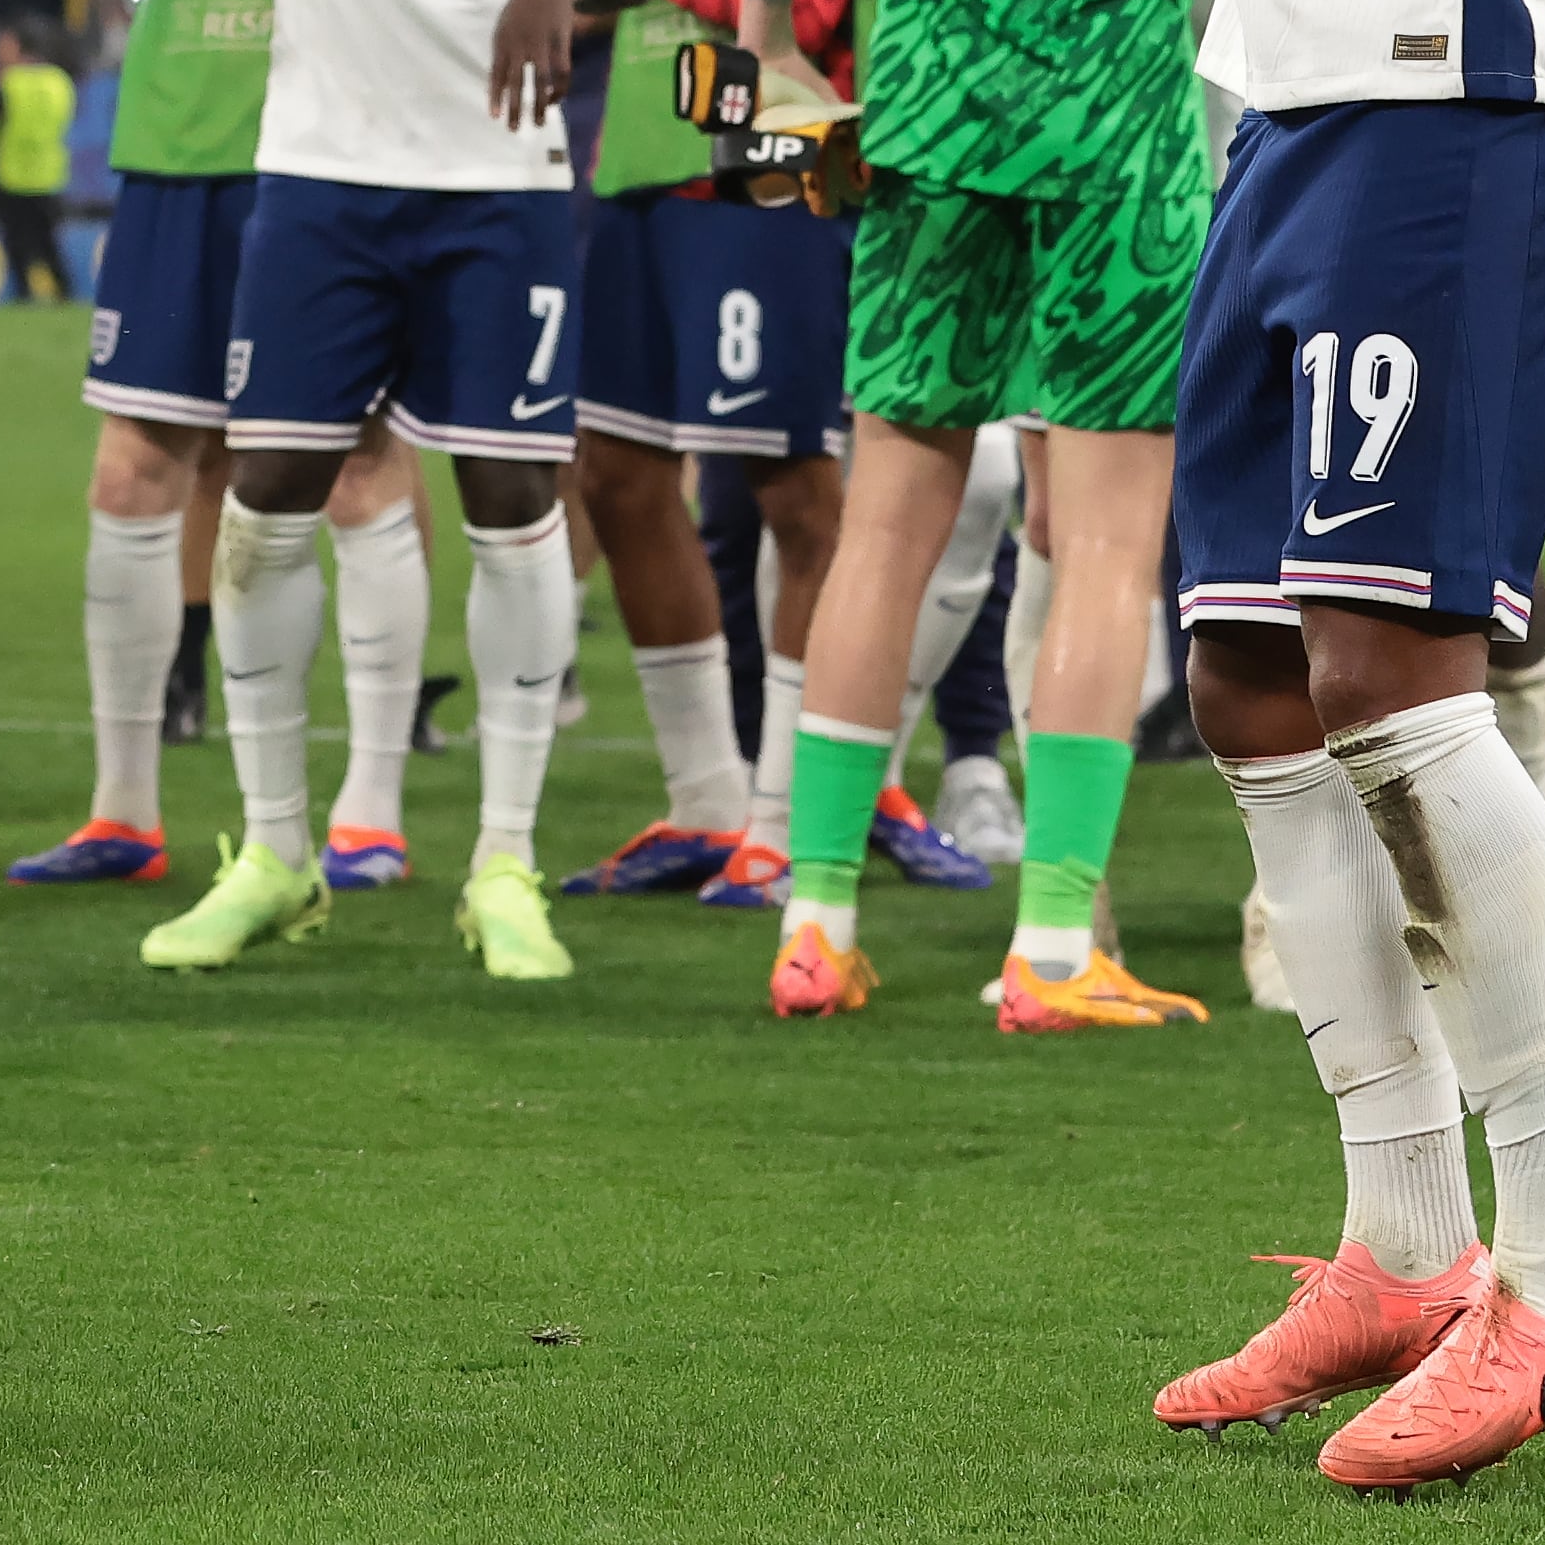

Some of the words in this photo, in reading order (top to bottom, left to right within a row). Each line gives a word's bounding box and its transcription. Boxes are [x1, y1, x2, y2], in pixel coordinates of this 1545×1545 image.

[745, 132, 806, 165] JP
[526, 284, 568, 386] 7
[717, 287, 763, 384] 8
[1302, 331, 1418, 483] 19
